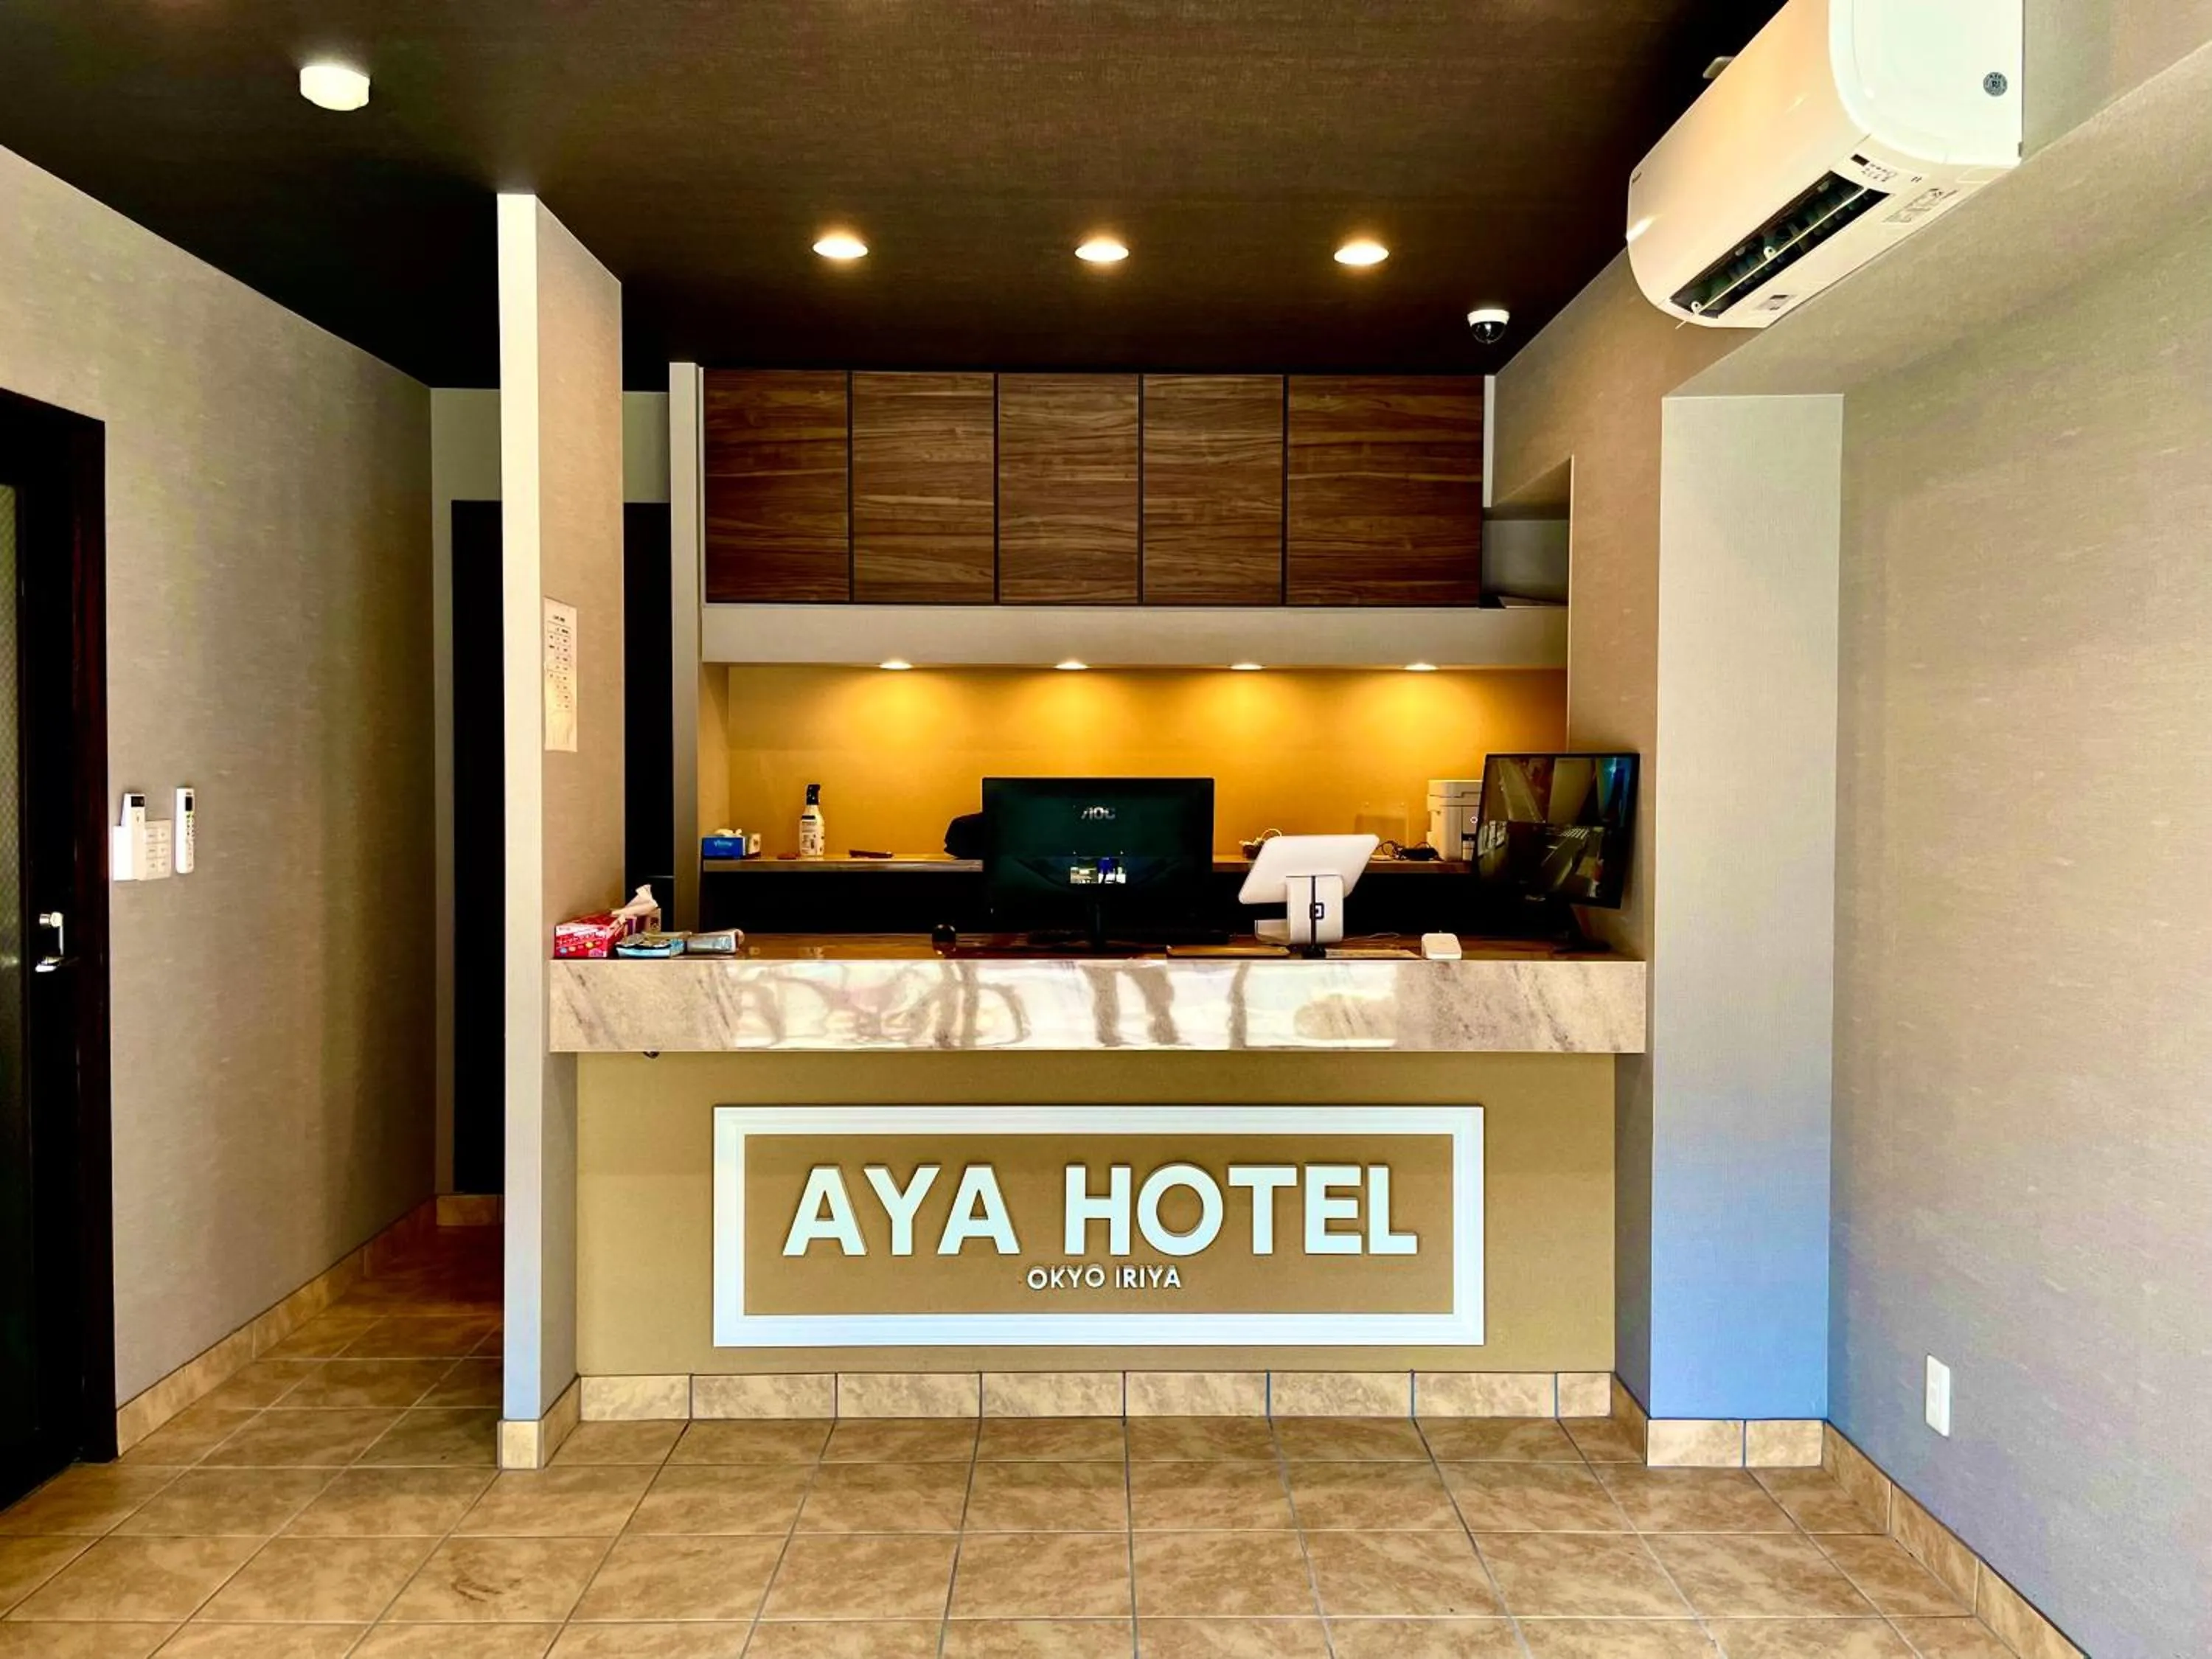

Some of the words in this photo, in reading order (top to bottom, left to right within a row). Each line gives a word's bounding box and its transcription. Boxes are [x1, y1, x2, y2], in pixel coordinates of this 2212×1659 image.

[1081, 807, 1116, 820] AOC
[782, 1164, 1020, 1256] AYA
[1065, 1163, 1417, 1256] HOTEL
[1027, 1265, 1105, 1290] OKYO
[1115, 1265, 1182, 1289] IRIYA
